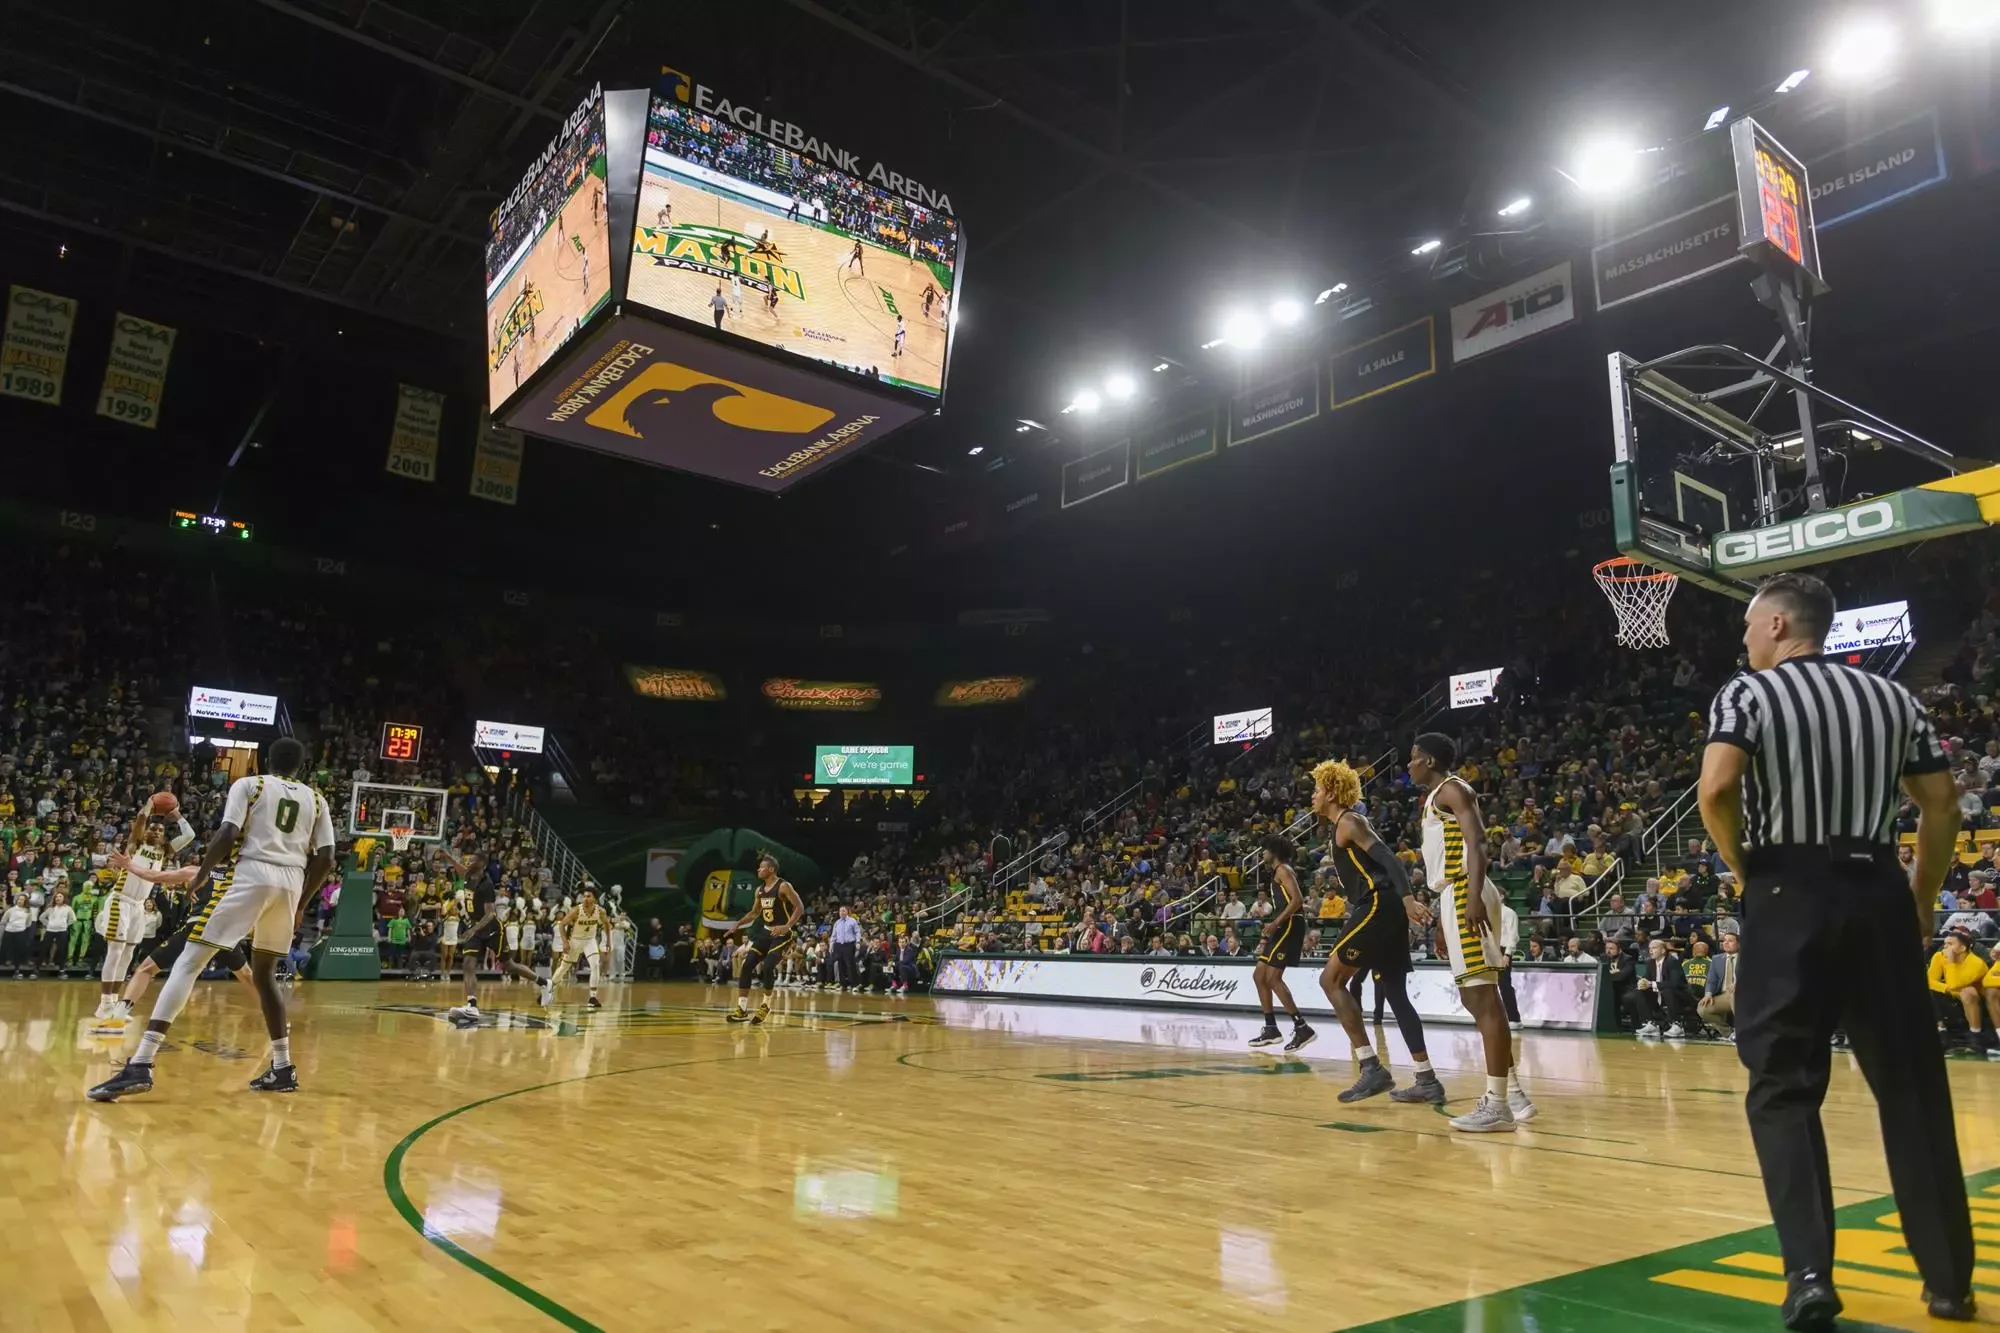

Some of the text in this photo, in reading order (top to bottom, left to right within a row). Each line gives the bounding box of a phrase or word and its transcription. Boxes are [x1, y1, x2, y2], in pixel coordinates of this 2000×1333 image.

[498, 81, 601, 226] EAGLEBANK ARENA
[694, 84, 955, 216] EAGLEBANK ARENA
[1810, 148, 1916, 201] ODE ISLAND
[634, 226, 802, 298] MASON
[1604, 222, 1731, 282] MASSACHUSETTS
[663, 258, 769, 292] PATRITS
[577, 343, 655, 397] EAGLEBANK
[1357, 349, 1405, 378] LA SALLE
[3, 373, 56, 398] 1989
[105, 396, 153, 423] 1999
[545, 393, 592, 422] ARENA
[1242, 397, 1304, 428] WASHINGTON
[758, 438, 834, 477] EAGLEBANK
[827, 414, 881, 442] ARENA
[391, 454, 431, 478] 2001
[475, 478, 514, 500] 2008
[59, 509, 96, 532] 123
[202, 516, 226, 528] 17:39
[232, 521, 246, 529] VCU
[1715, 501, 1894, 566] GEICO
[241, 530, 249, 539] 6
[312, 557, 346, 576] 124
[1834, 640, 1861, 651] HVAC
[1863, 634, 1902, 647] Experts
[195, 709, 268, 723] NoVa's HVAC Experts
[390, 727, 418, 740] 17:39
[388, 738, 413, 757] 23
[859, 746, 889, 754] SPONSOR
[852, 760, 909, 771] we're game
[275, 797, 300, 834] 0
[1157, 967, 1239, 1001] Academy
